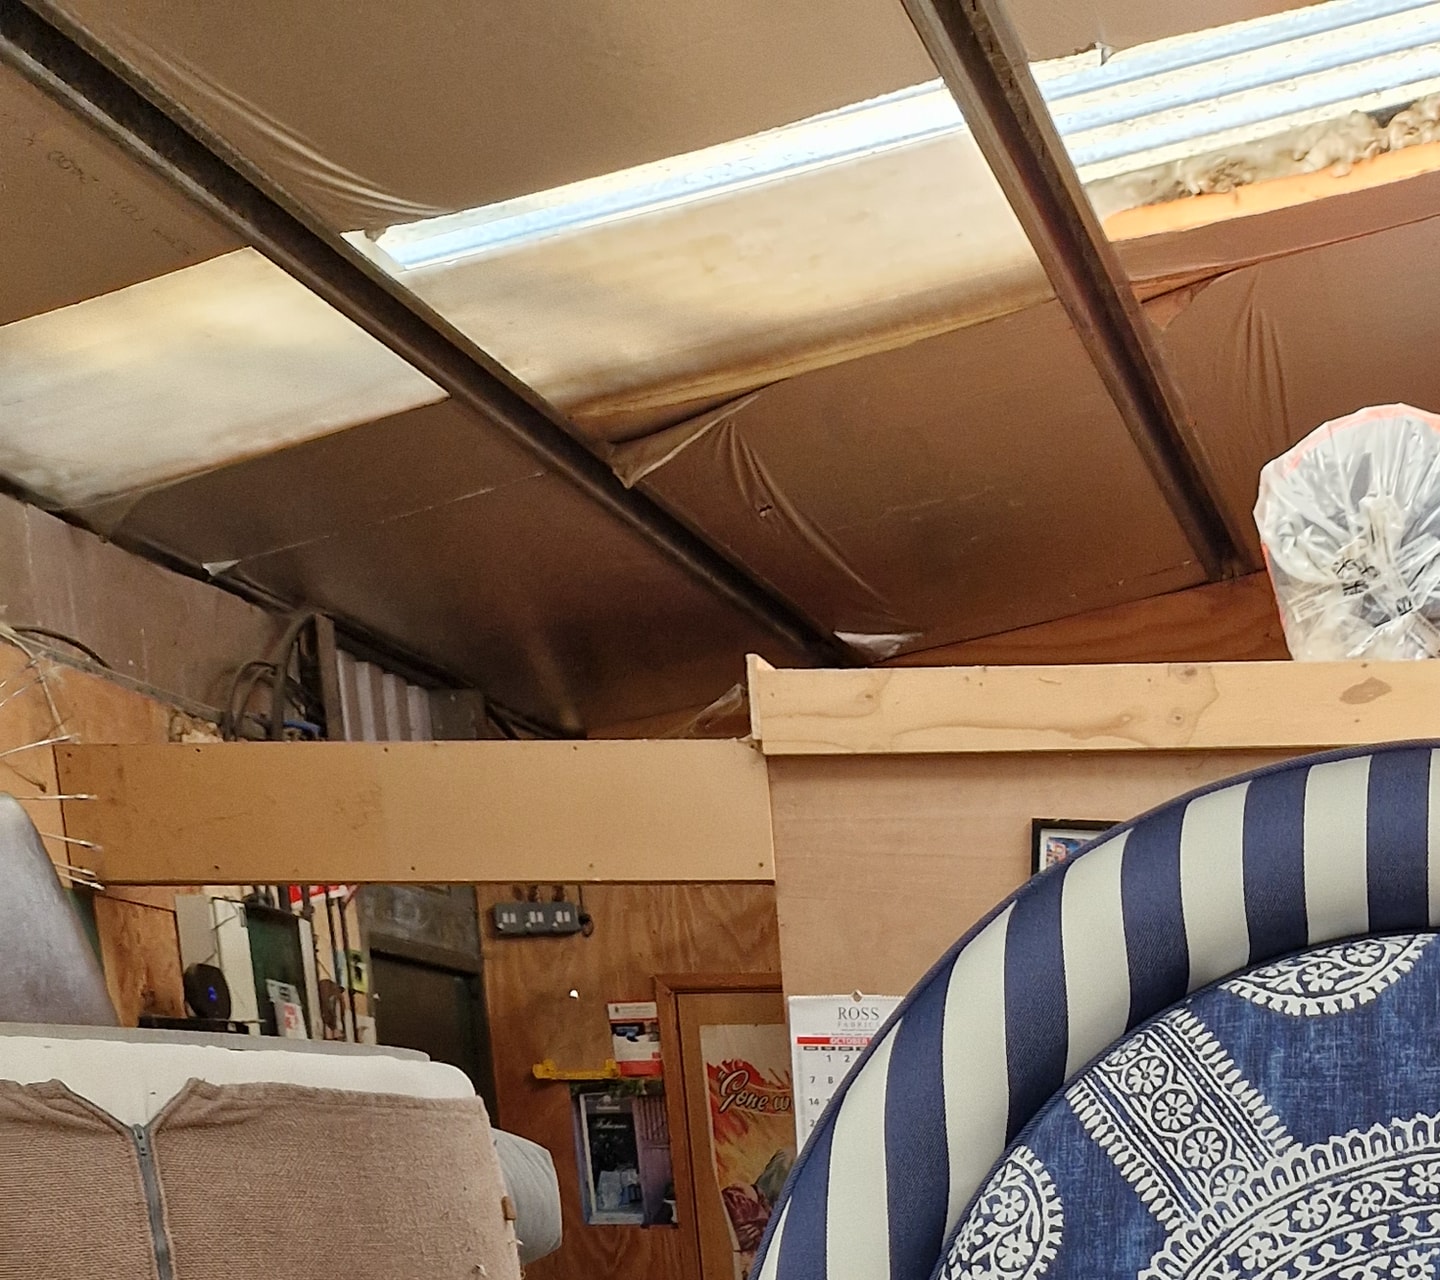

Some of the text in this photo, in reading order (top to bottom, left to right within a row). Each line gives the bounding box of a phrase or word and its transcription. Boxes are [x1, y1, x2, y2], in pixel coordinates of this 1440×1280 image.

[838, 1006, 880, 1021] ROSS
[830, 1037, 869, 1045] OCTOBER
[809, 1098, 820, 1106] 14
